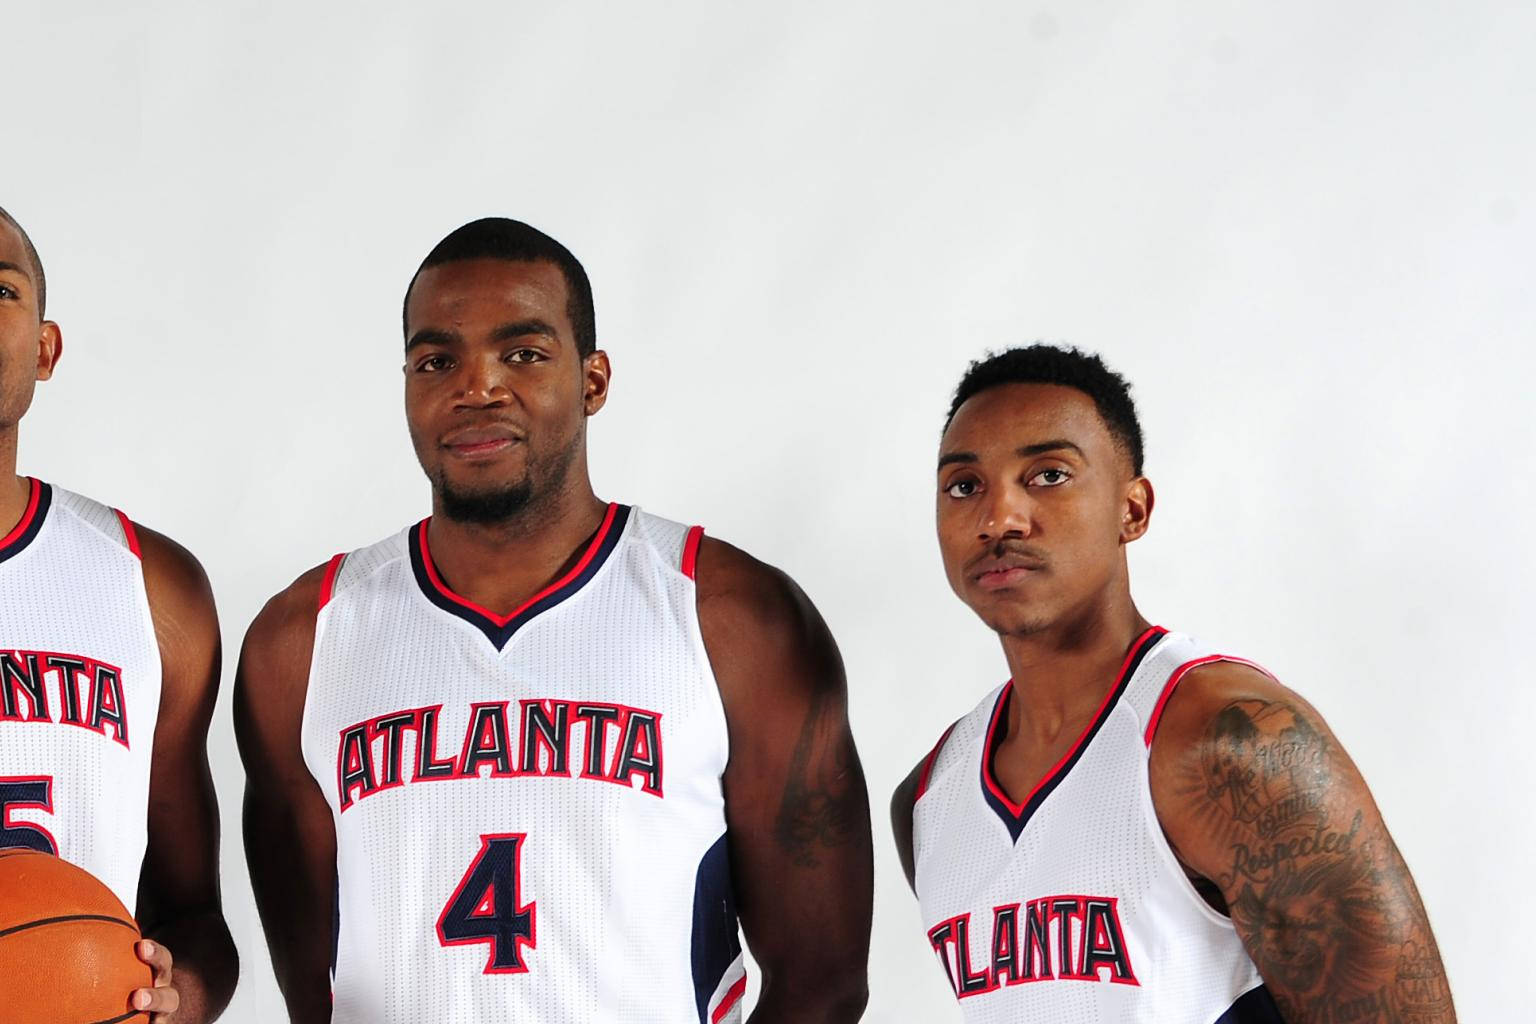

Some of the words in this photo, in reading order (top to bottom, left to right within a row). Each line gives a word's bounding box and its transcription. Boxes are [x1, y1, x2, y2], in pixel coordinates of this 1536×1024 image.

[337, 699, 663, 814] ATLANTA
[436, 832, 536, 975] 4
[1217, 809, 1362, 888] Respected
[927, 894, 1141, 1000] TLANTA
